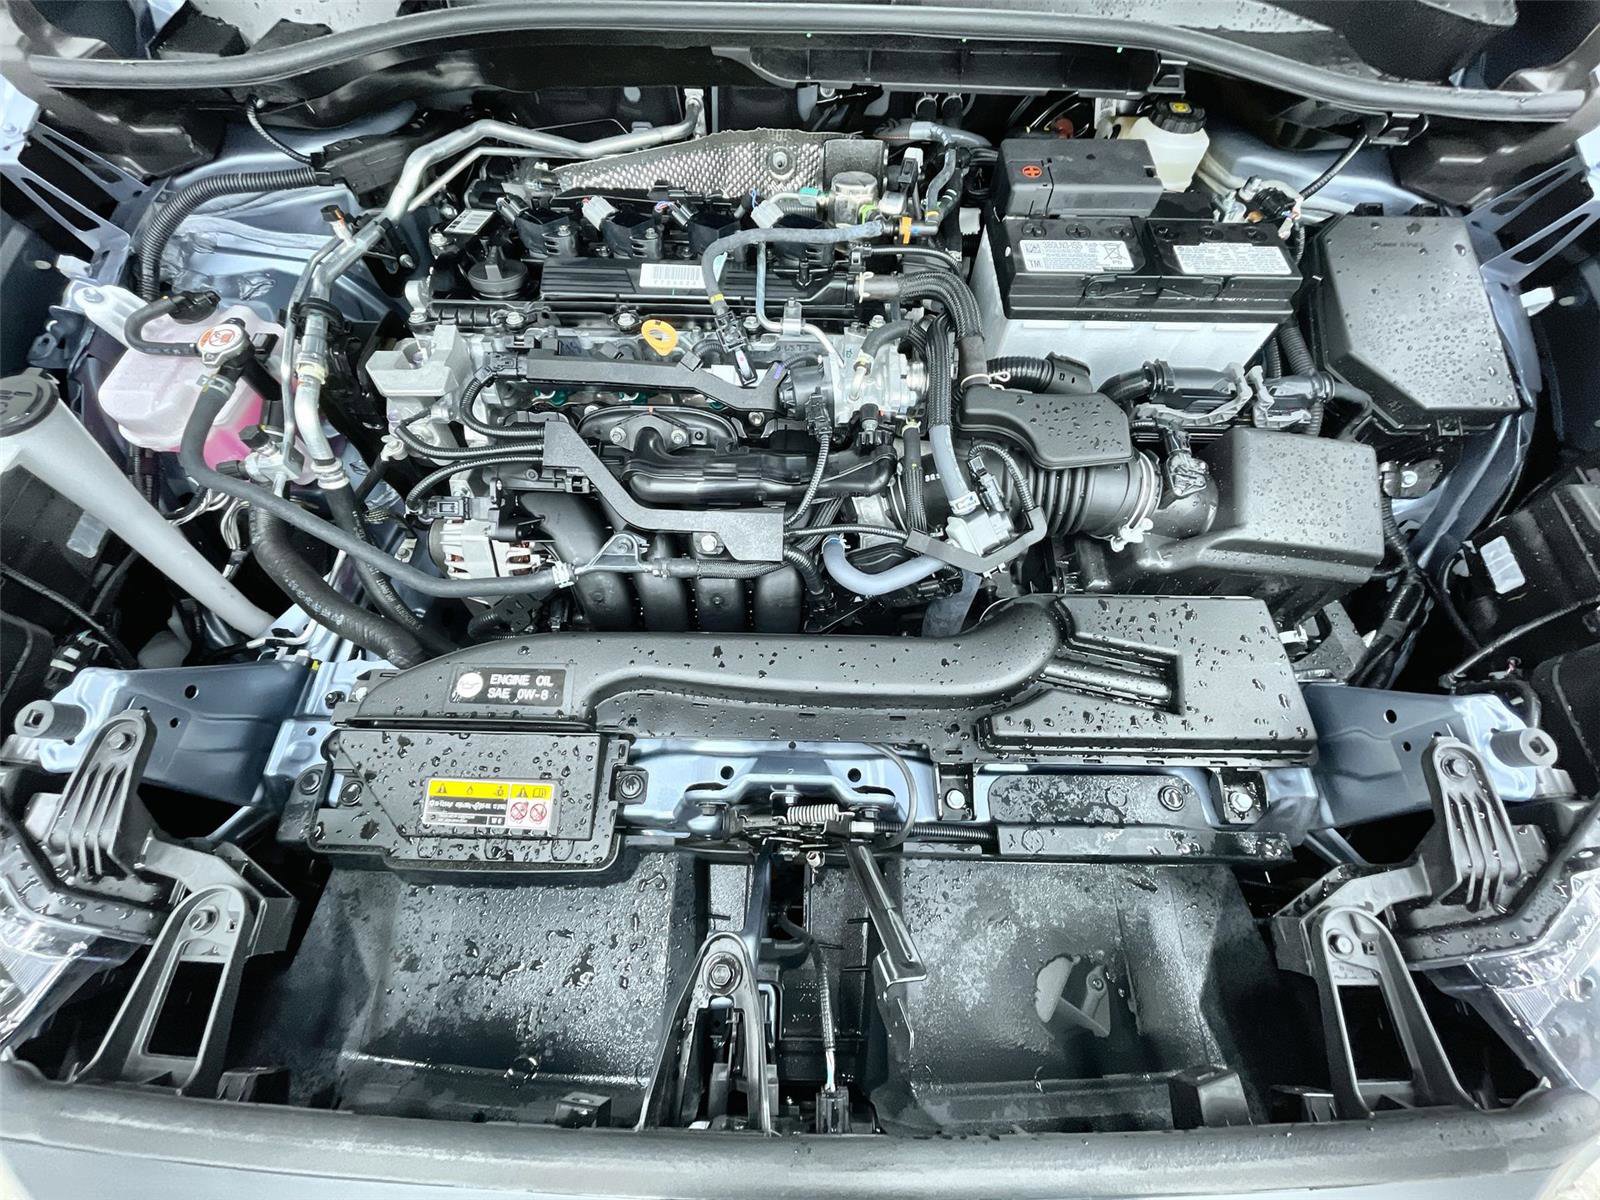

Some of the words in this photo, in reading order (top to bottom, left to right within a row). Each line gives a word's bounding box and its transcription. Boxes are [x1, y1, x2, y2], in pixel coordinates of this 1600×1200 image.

[489, 673, 531, 686] ENGINE
[535, 675, 554, 687] OIL
[487, 688, 511, 699] SAE
[516, 688, 549, 701] 0W-8
